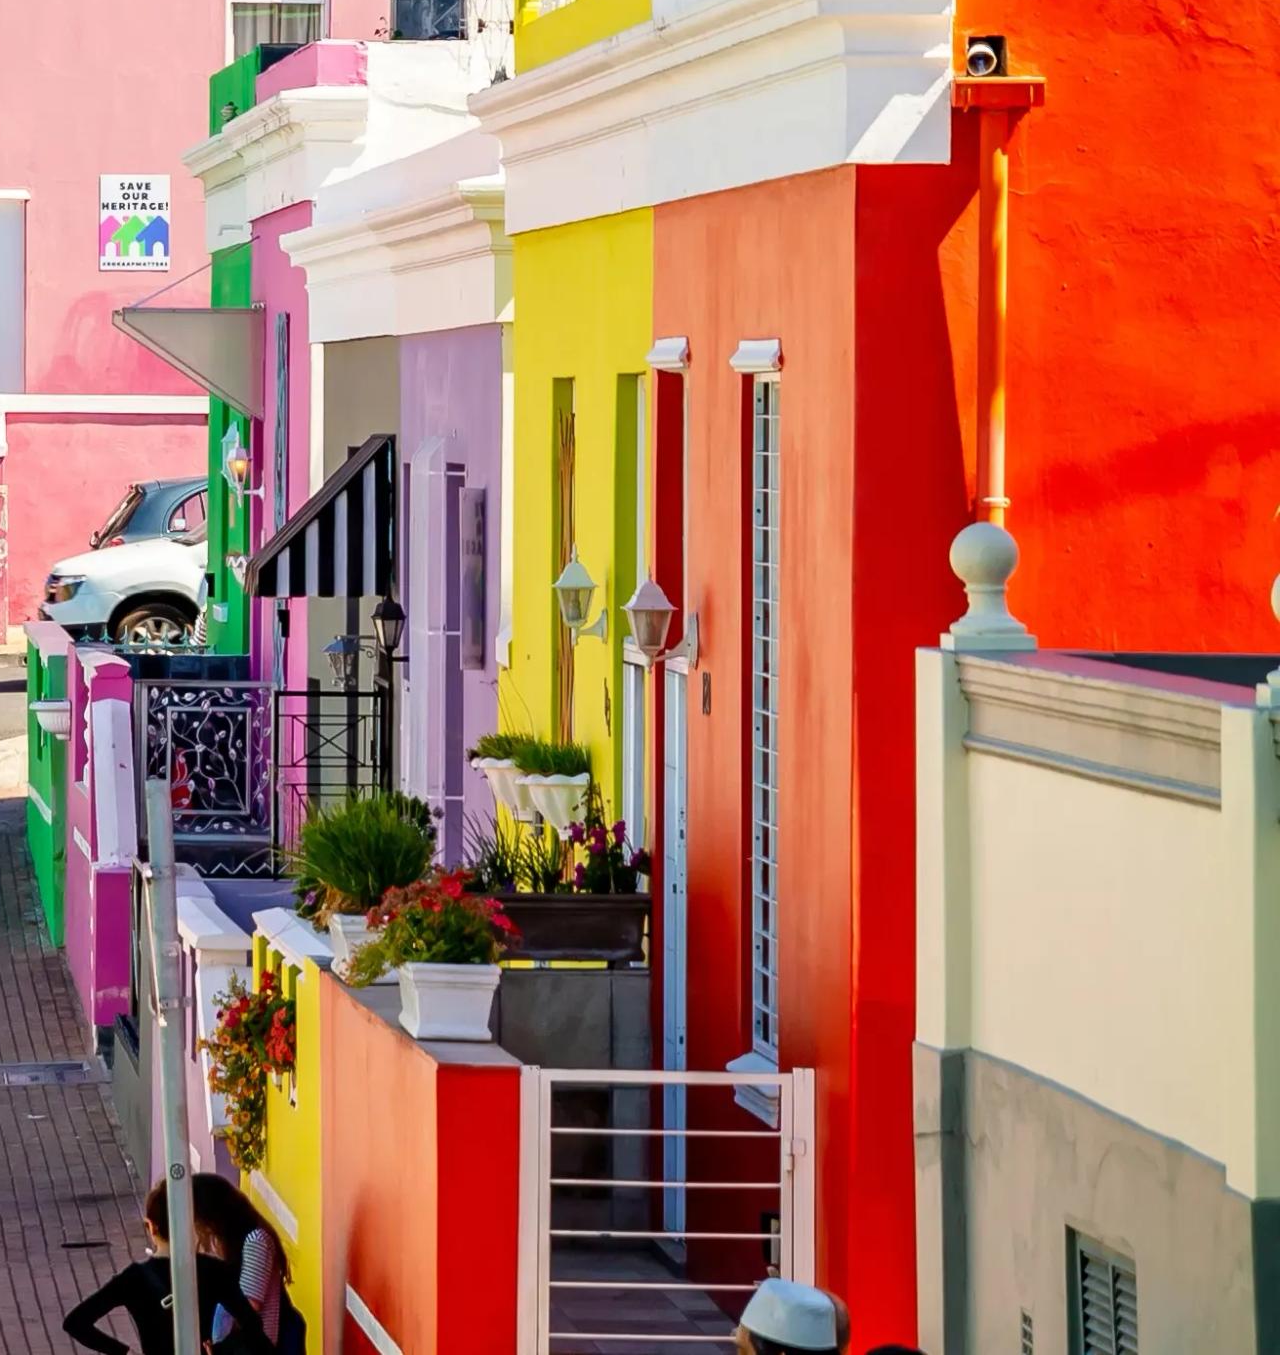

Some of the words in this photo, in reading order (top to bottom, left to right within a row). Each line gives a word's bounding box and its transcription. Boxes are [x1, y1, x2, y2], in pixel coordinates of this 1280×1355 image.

[120, 182, 151, 190] SAVE
[122, 192, 149, 200] OUR
[102, 202, 168, 210] HERITAGE!
